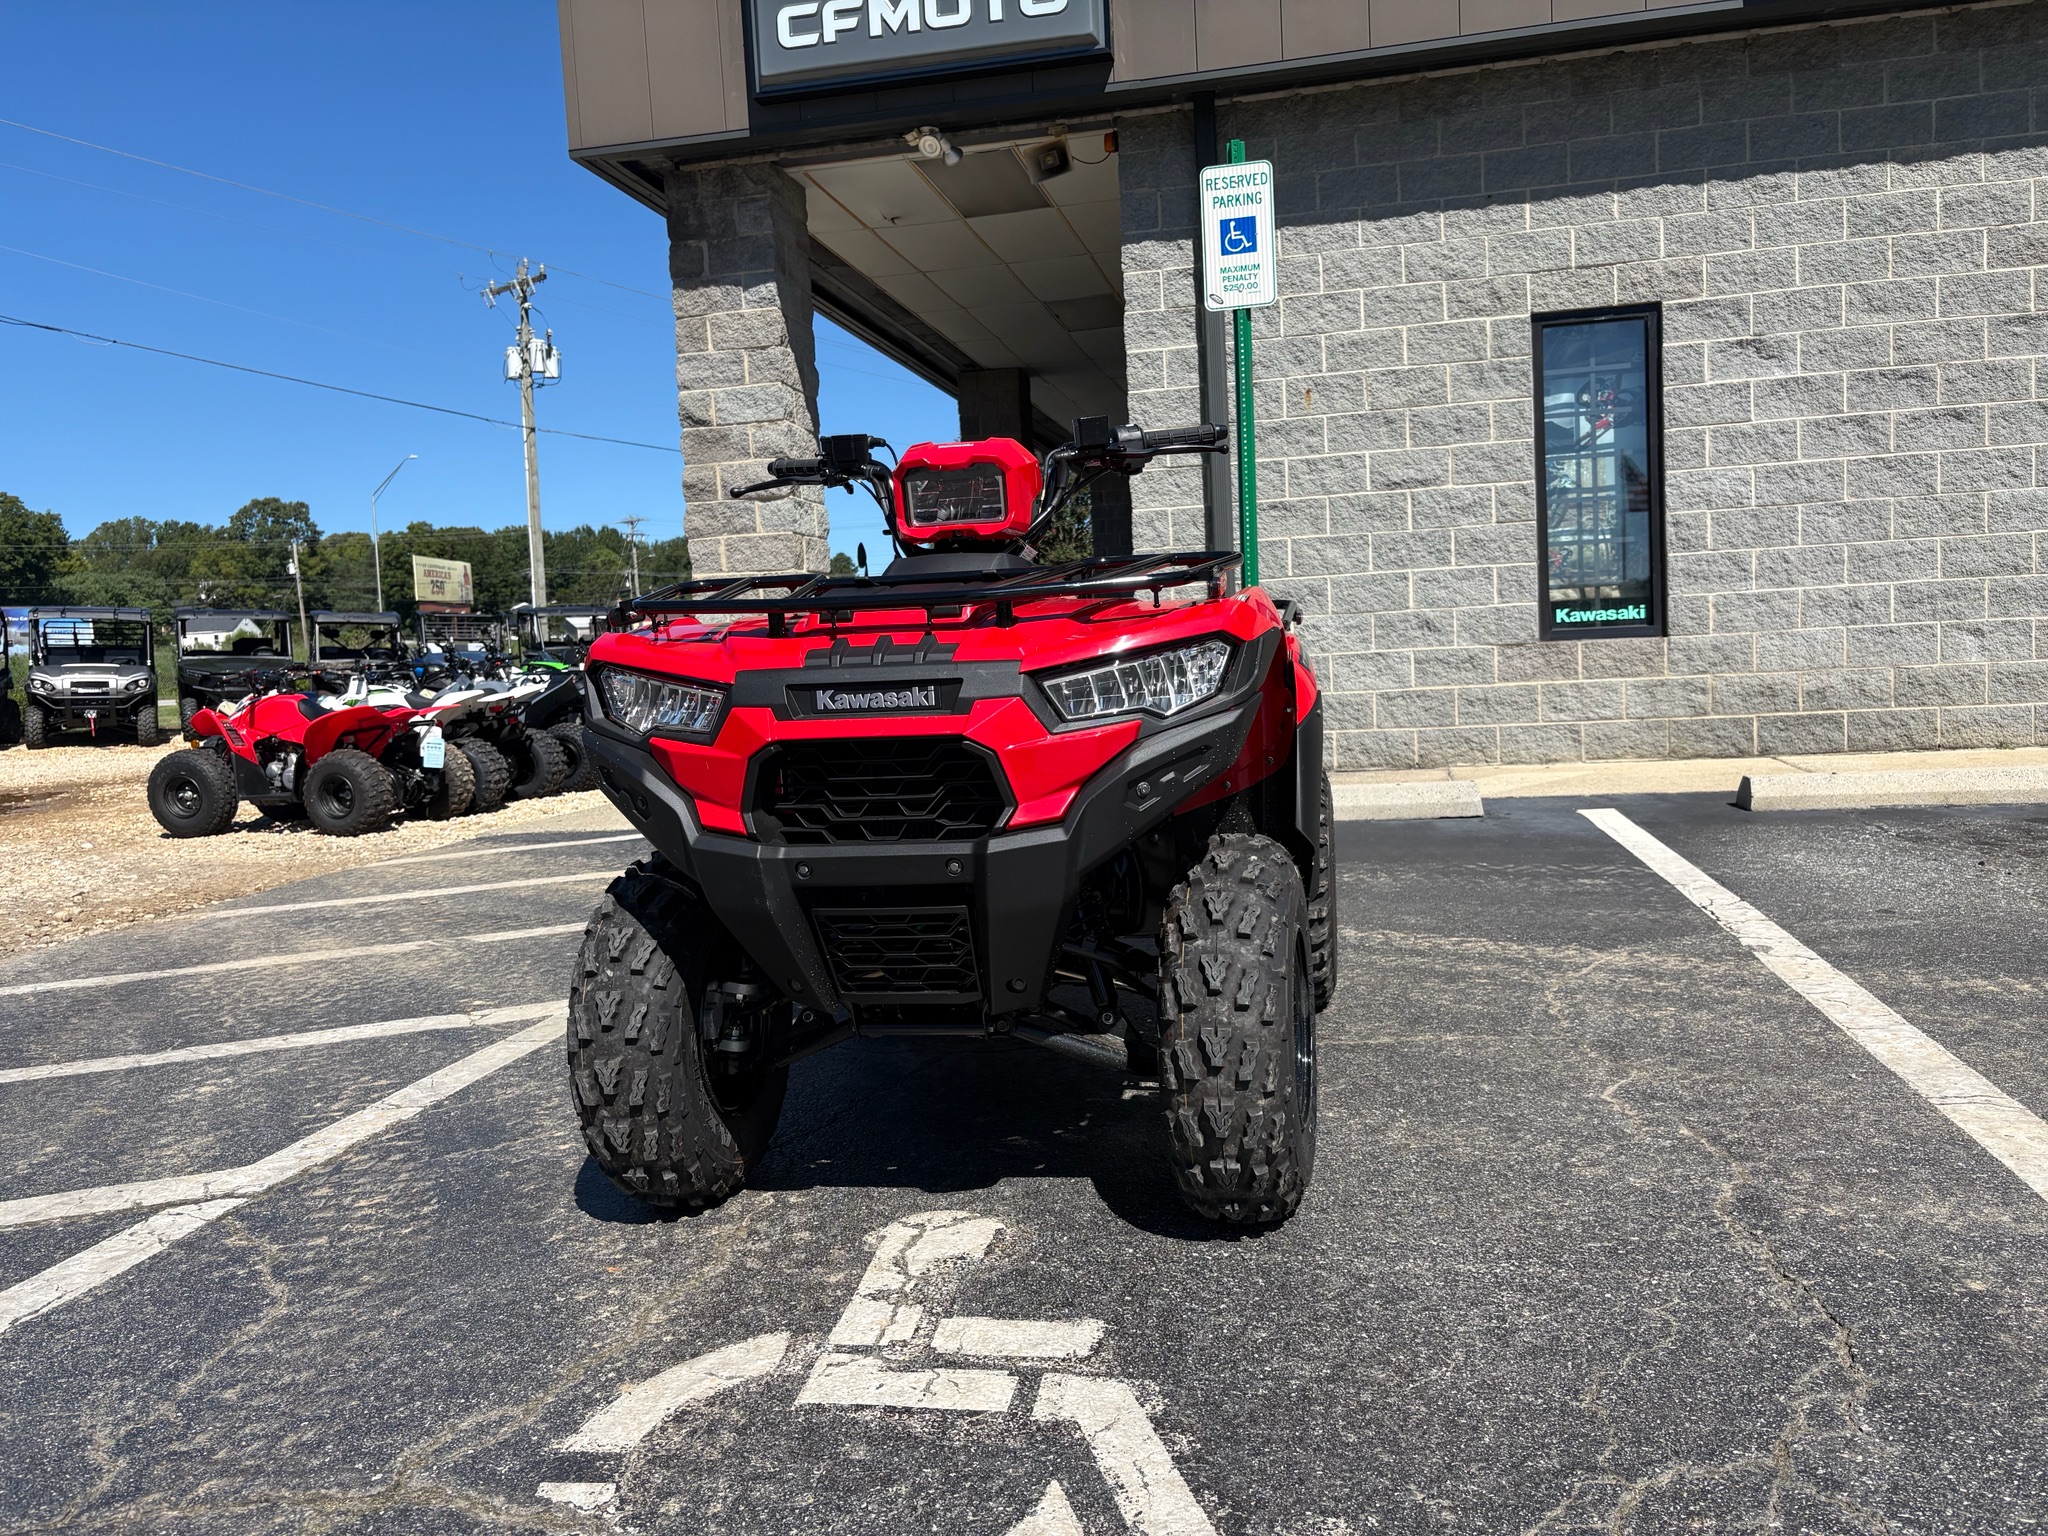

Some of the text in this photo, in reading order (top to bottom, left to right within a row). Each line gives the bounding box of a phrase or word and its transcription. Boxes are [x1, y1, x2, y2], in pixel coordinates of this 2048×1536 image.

[1205, 172, 1268, 191] RESERVED
[1212, 191, 1263, 210] PARKING
[1220, 263, 1261, 274] MAXIMUM
[1222, 273, 1258, 283] PENALTY
[1223, 281, 1259, 293] $250.00
[1555, 604, 1646, 623] Kawasaki
[816, 685, 936, 710] Kawasaki
